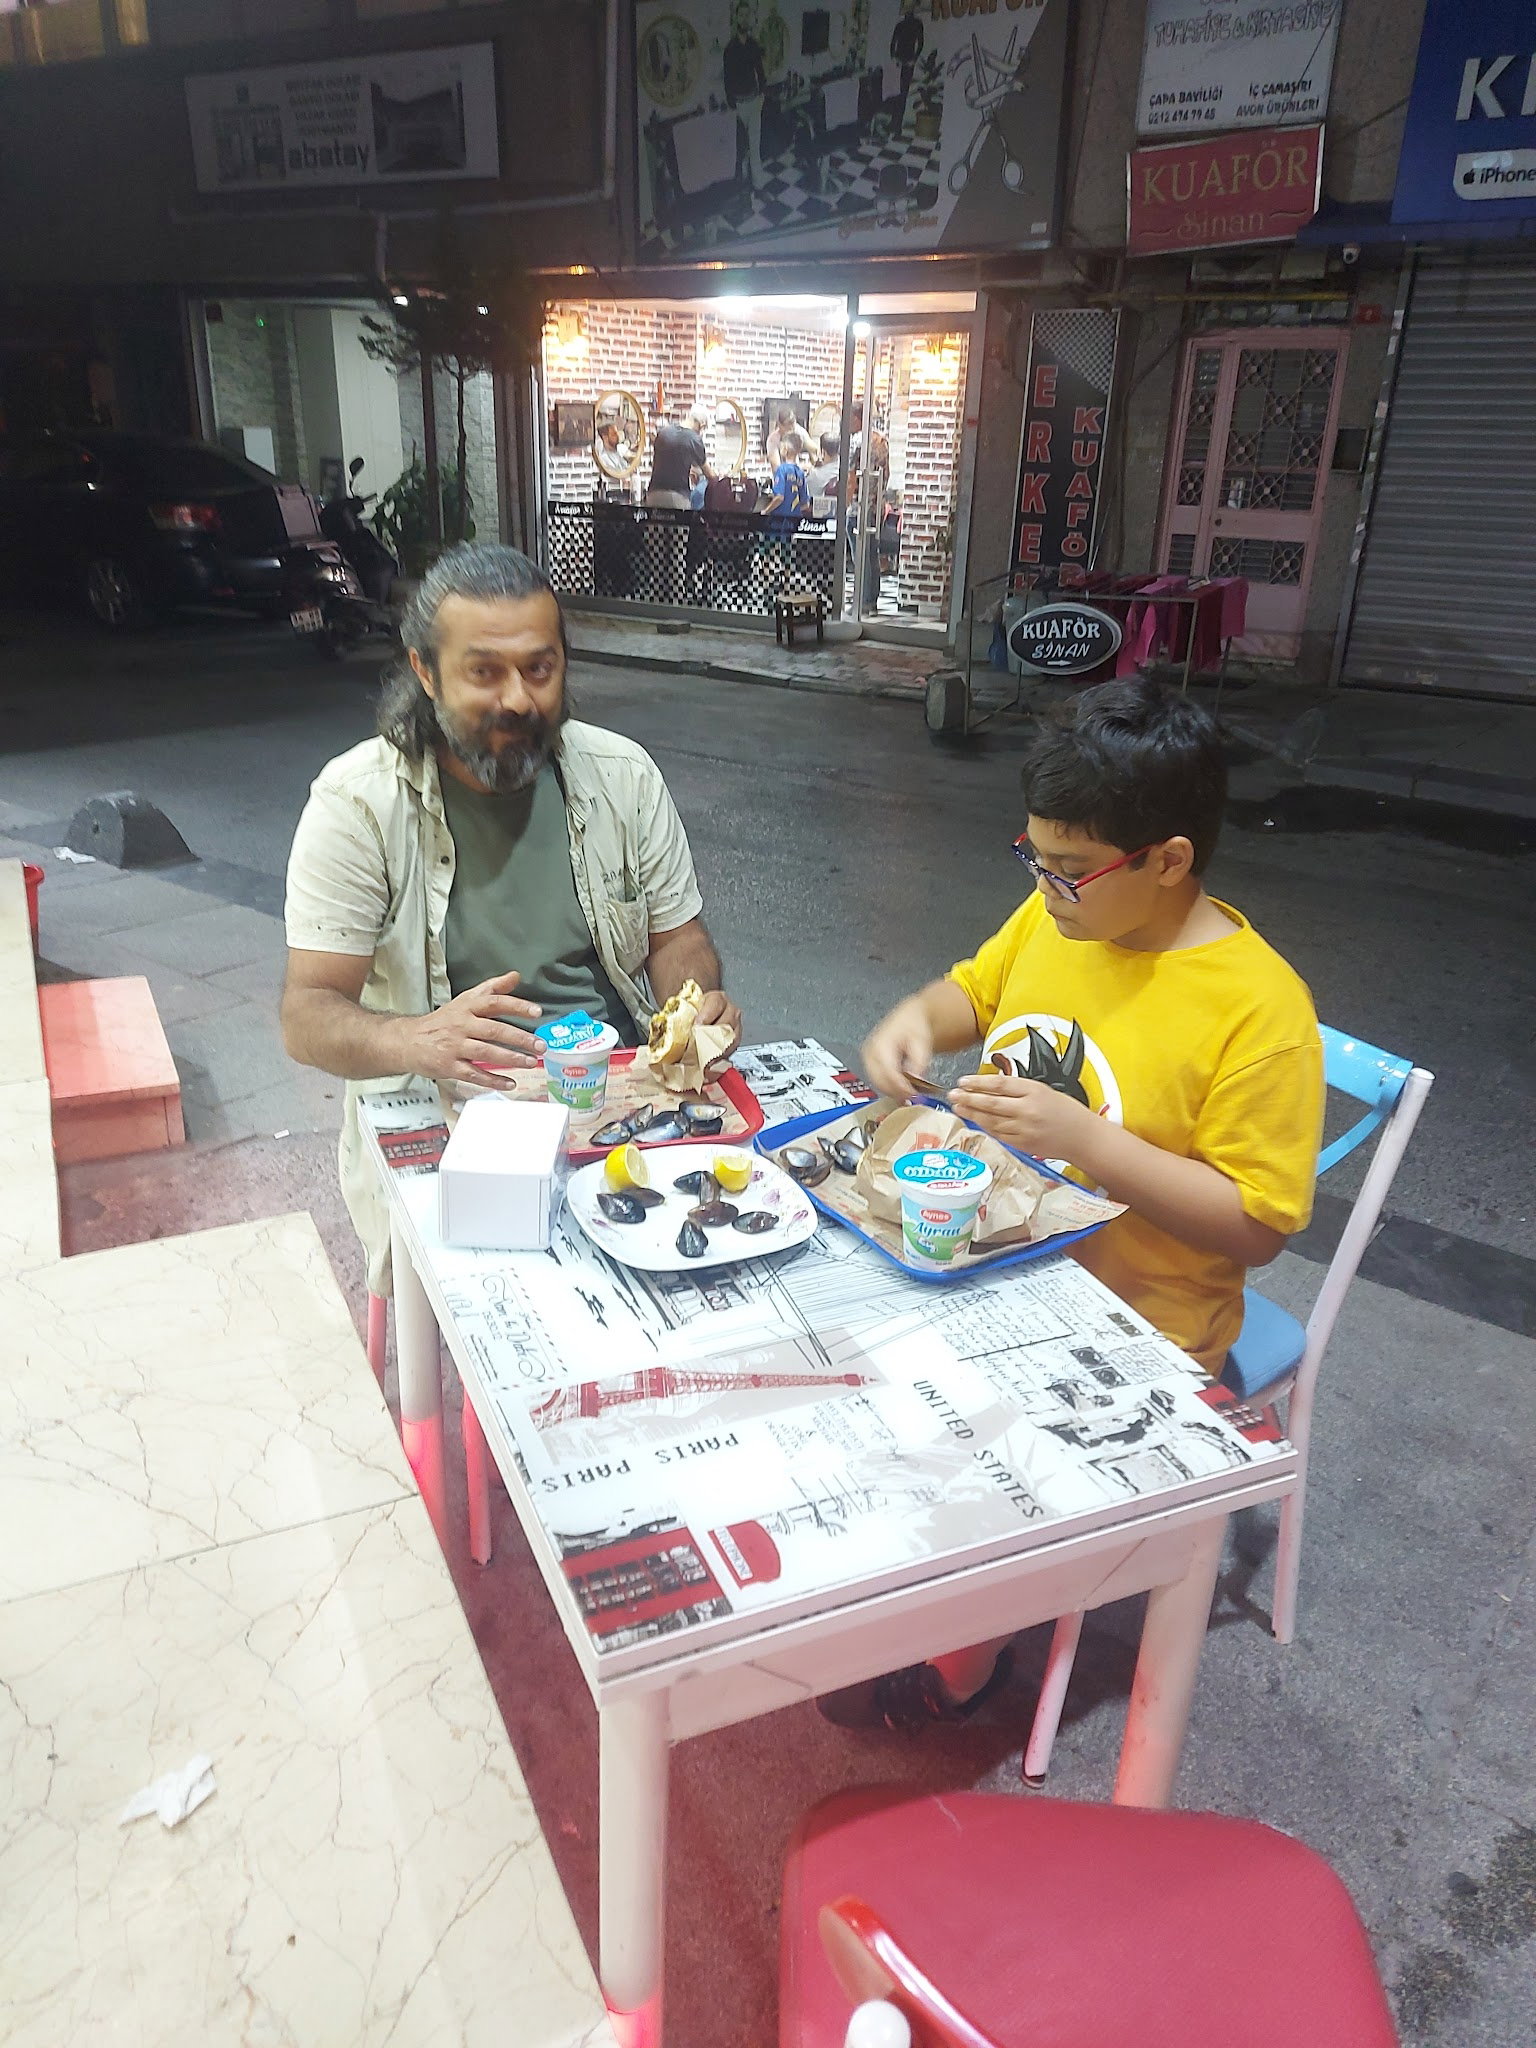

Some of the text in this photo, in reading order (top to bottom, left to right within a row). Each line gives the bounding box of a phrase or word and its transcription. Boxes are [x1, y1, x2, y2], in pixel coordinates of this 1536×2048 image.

[1455, 53, 1536, 121] K
[1236, 104, 1263, 118] AVON
[1142, 139, 1309, 206] KUAFÖR
[1480, 167, 1536, 184] iPhone
[1177, 210, 1264, 241] Sinan
[1058, 406, 1104, 588] KUAFÖR
[1022, 616, 1101, 641] KUAFÖR
[913, 1221, 961, 1238] Ayran
[922, 1209, 950, 1221] Aynes
[654, 1432, 739, 1464] PARIS
[913, 1380, 974, 1439] UNITED
[973, 1450, 1044, 1518] STATES
[541, 1459, 631, 1493] PARIS
